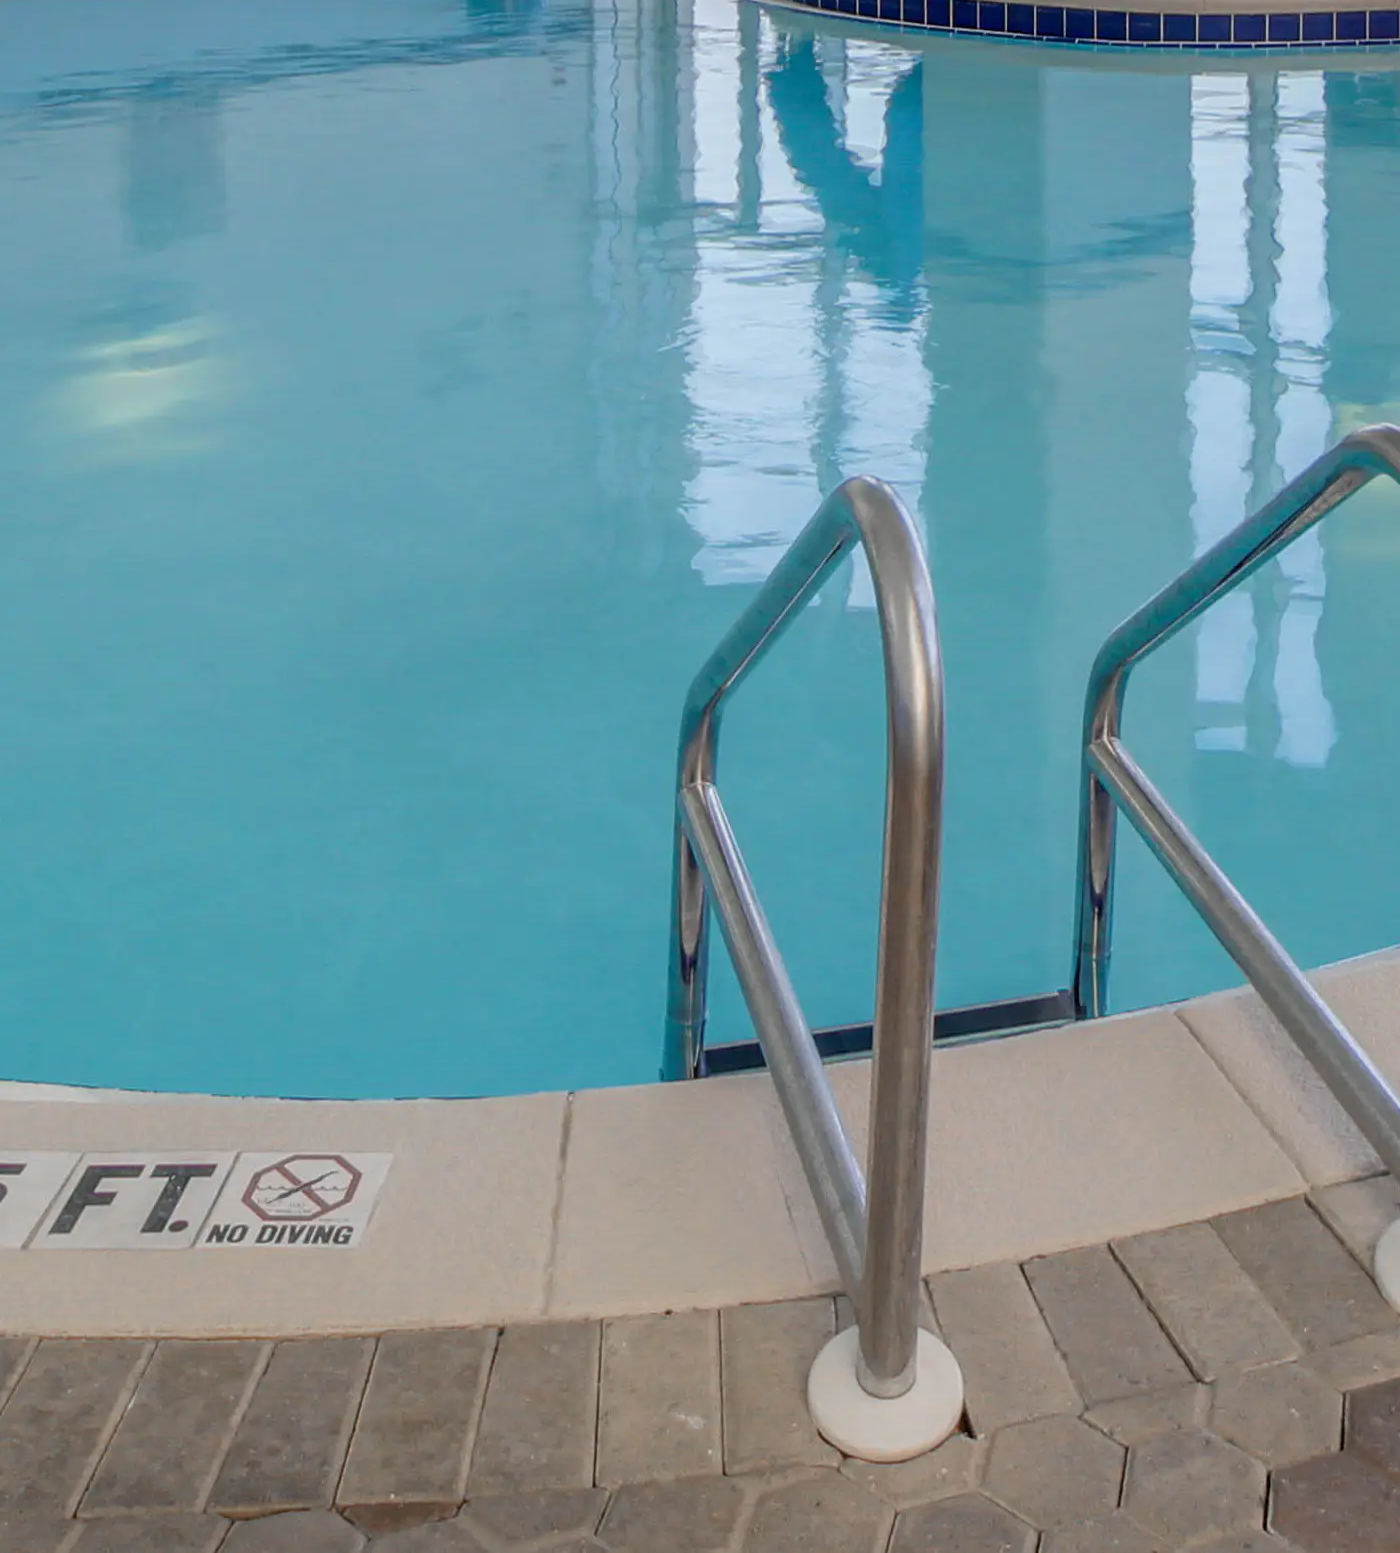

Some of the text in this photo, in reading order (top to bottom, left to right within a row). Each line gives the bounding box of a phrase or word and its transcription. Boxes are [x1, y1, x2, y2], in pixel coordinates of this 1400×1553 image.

[48, 1163, 218, 1235] FT.
[206, 1224, 354, 1245] NO DIVING
